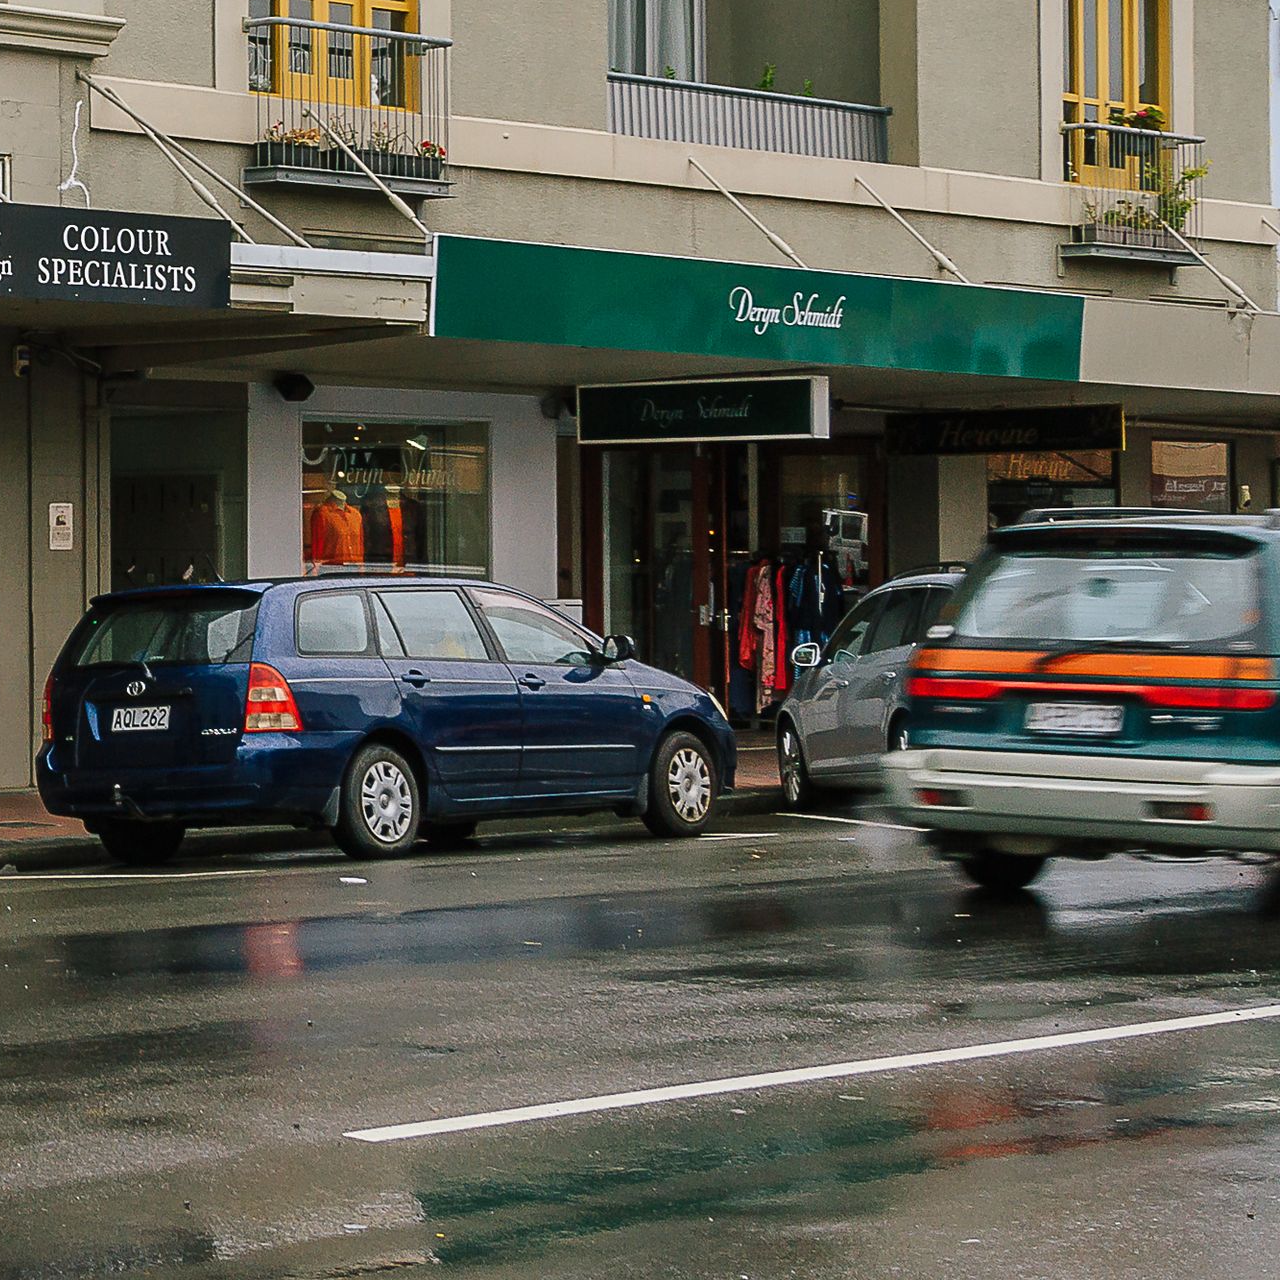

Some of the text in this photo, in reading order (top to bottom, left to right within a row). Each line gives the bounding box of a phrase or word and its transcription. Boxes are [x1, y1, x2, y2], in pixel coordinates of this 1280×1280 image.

[62, 224, 172, 256] COLOUR
[37, 257, 197, 292] SPECIALISTS
[729, 286, 847, 335] Deryn Schmidt
[640, 394, 753, 429] Deryn Schmidt
[936, 419, 1040, 448] Heroine
[113, 708, 168, 729] AQL262
